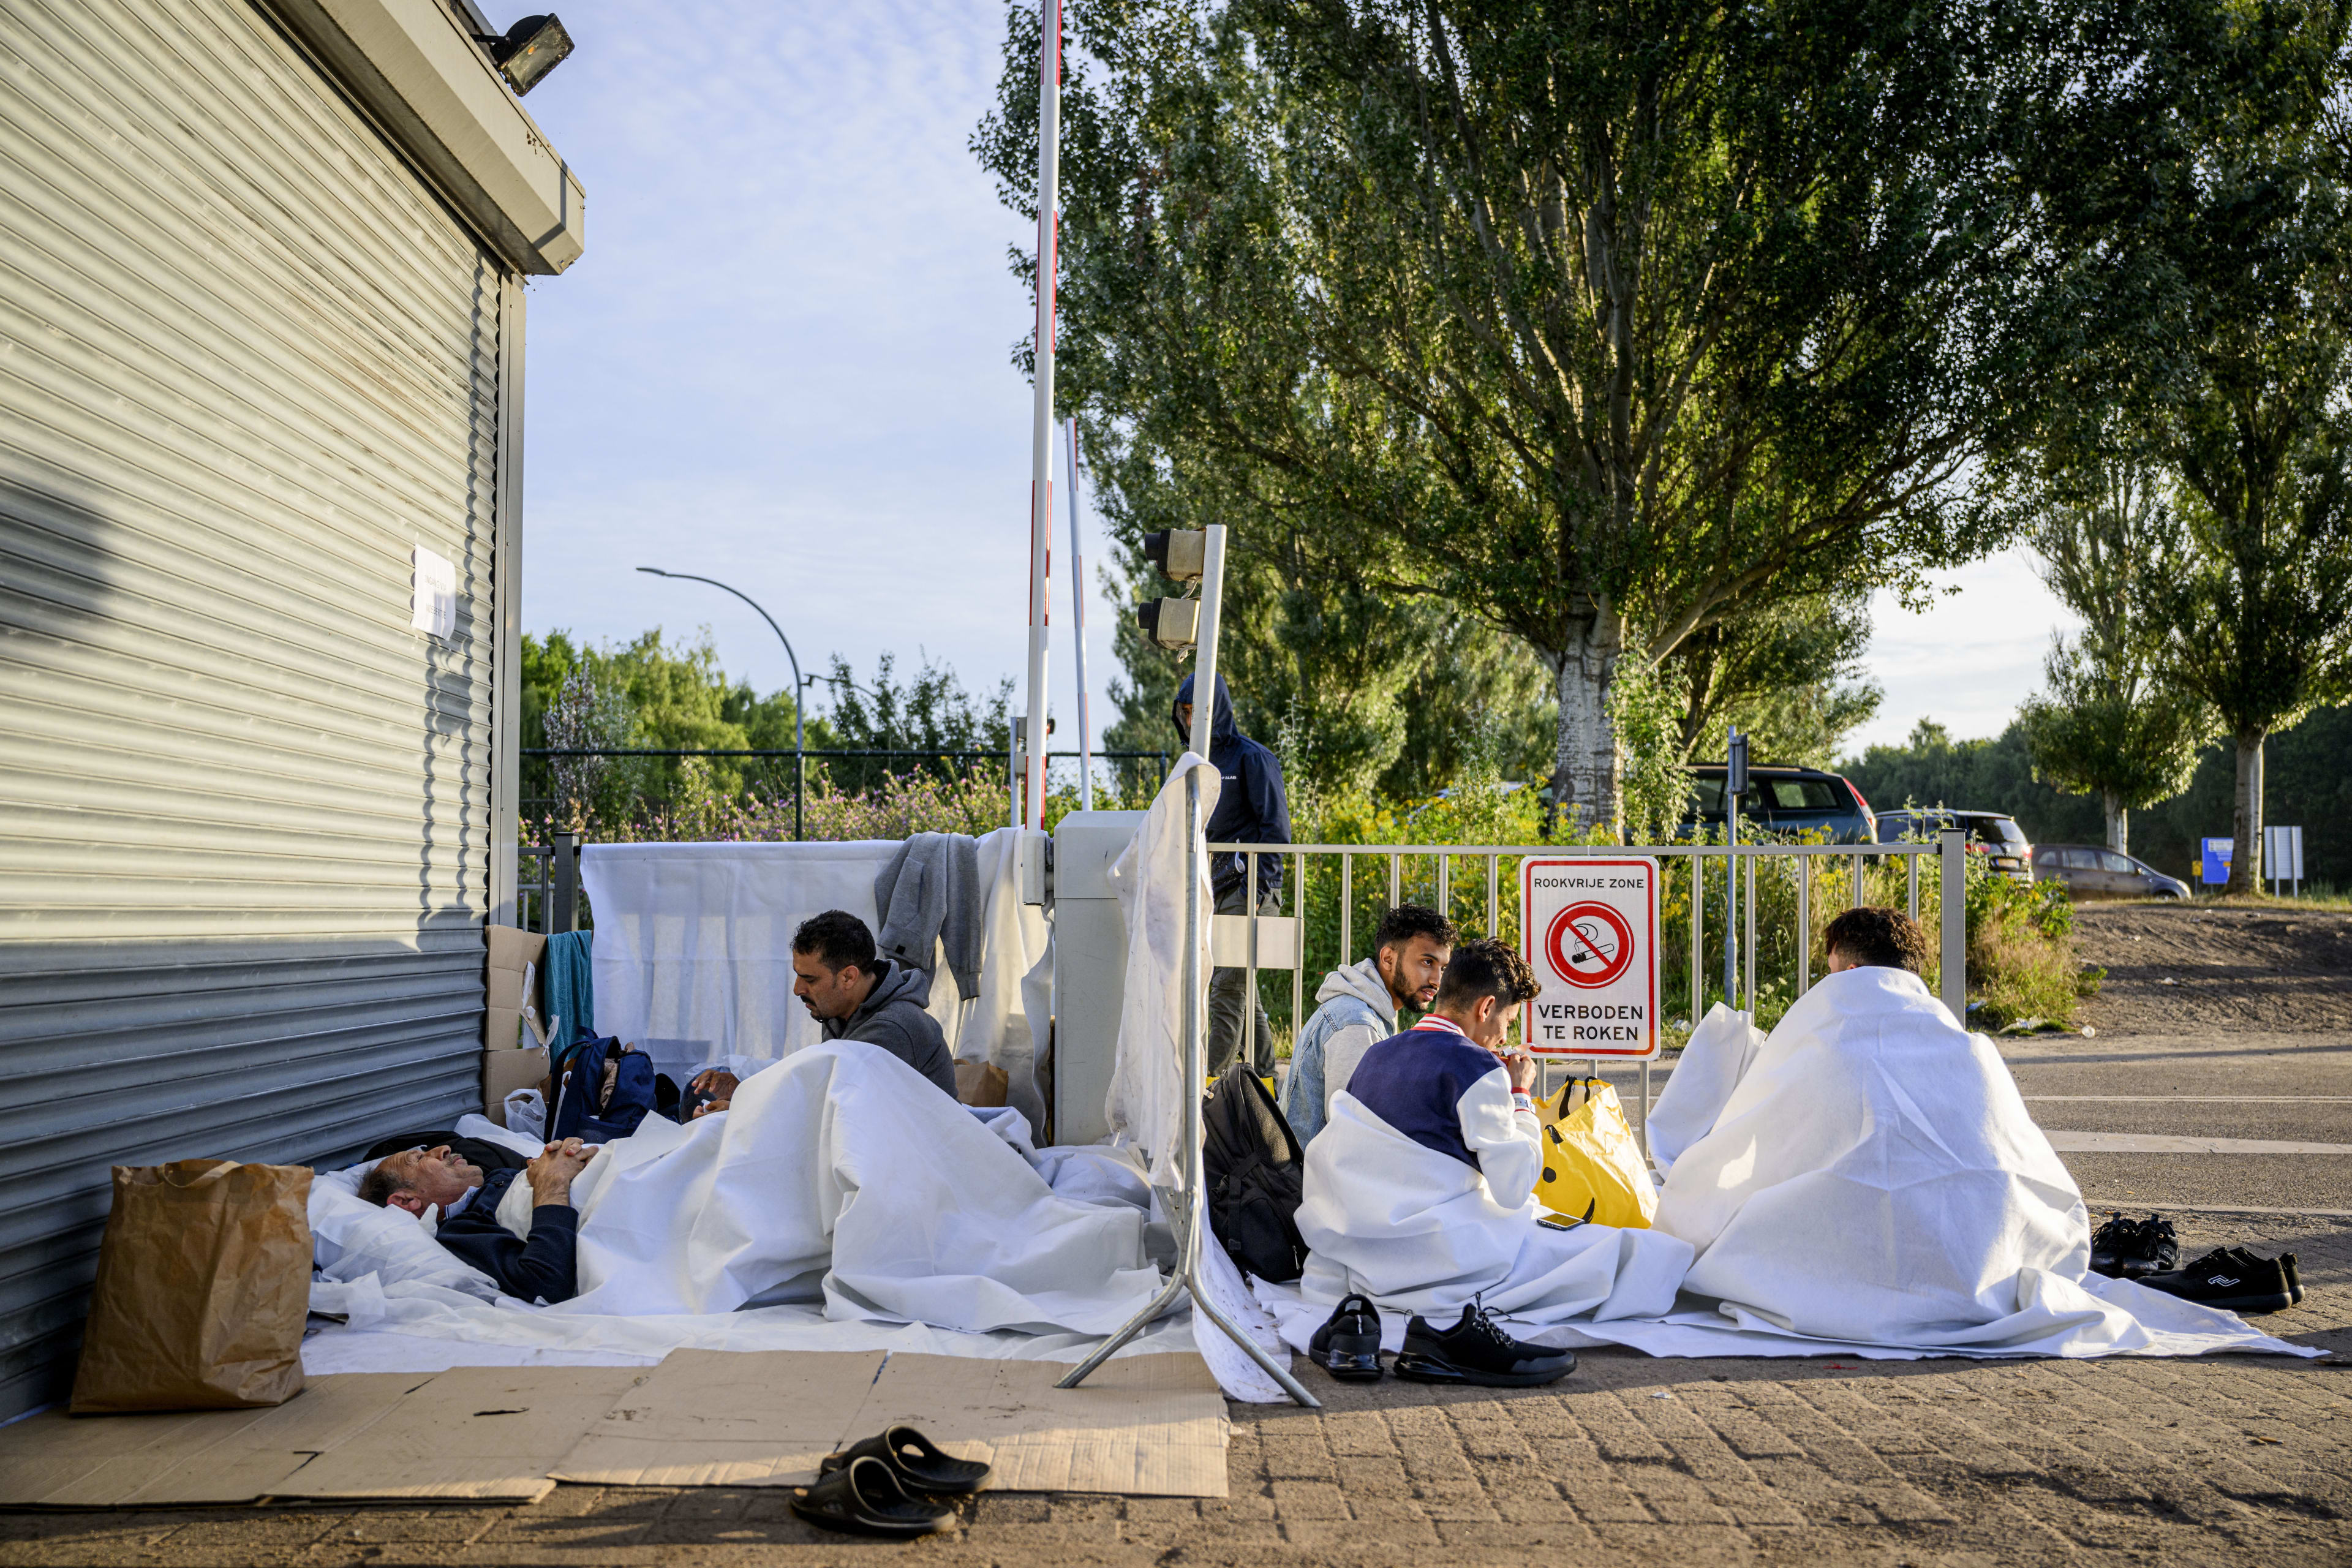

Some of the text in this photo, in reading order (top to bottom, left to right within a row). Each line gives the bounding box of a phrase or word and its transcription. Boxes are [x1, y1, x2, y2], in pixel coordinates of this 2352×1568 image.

[1535, 878, 1643, 888] ROOKVRIJE ZONE
[1538, 1005, 1642, 1019] VERBODEN
[1543, 1025, 1638, 1040] TE ROKEN
